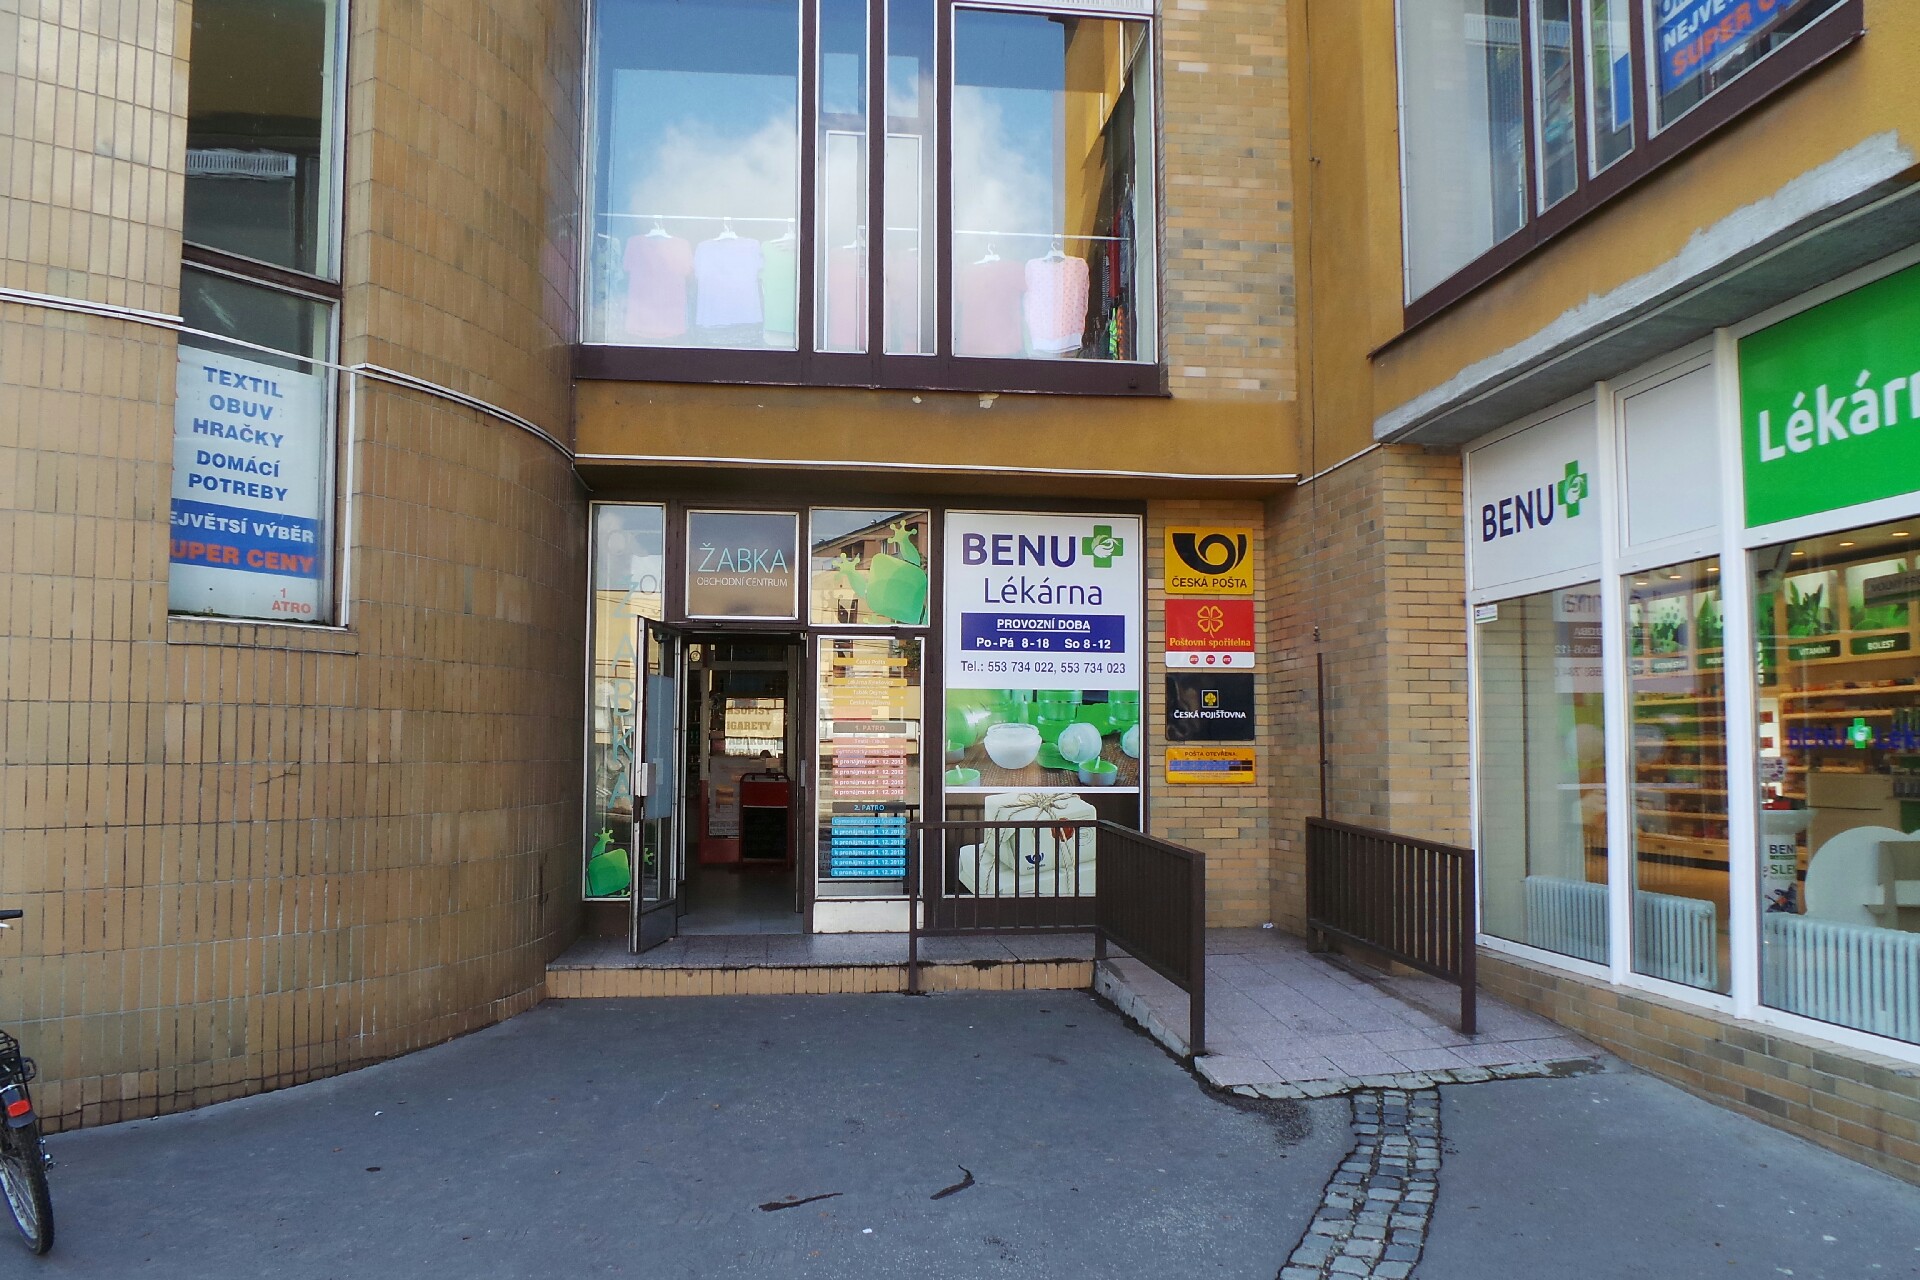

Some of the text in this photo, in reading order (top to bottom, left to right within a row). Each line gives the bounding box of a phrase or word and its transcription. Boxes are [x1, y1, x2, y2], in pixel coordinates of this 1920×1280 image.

[1672, 2, 1753, 77] SUPER
[203, 366, 283, 398] TEXTIL
[209, 394, 274, 421] OBUV
[193, 417, 284, 448] HRAČKY
[196, 450, 280, 477] DOMÁCÍ
[188, 473, 288, 501] POTREBY
[1482, 484, 1554, 542] BENU
[253, 521, 314, 544] VÝBĚR
[246, 549, 315, 574] CENY
[697, 542, 789, 574] ŽABKA
[962, 533, 1076, 568] BENU
[696, 577, 788, 587] OBCHODNÍ CENTRUM
[984, 576, 1103, 606] Lékárna
[1171, 575, 1247, 588] ČESKÁ POŠTA
[997, 617, 1091, 630] PROVOZNÍ DOBA
[1064, 639, 1080, 649] So
[1169, 636, 1251, 648] Poštovní spořitelna
[1867, 639, 1896, 650] BOLEST
[961, 660, 1126, 675] Tel.: 553 734 022, 553 734 023
[1173, 709, 1247, 720] ČESKÁ POJIŠŤOVNA
